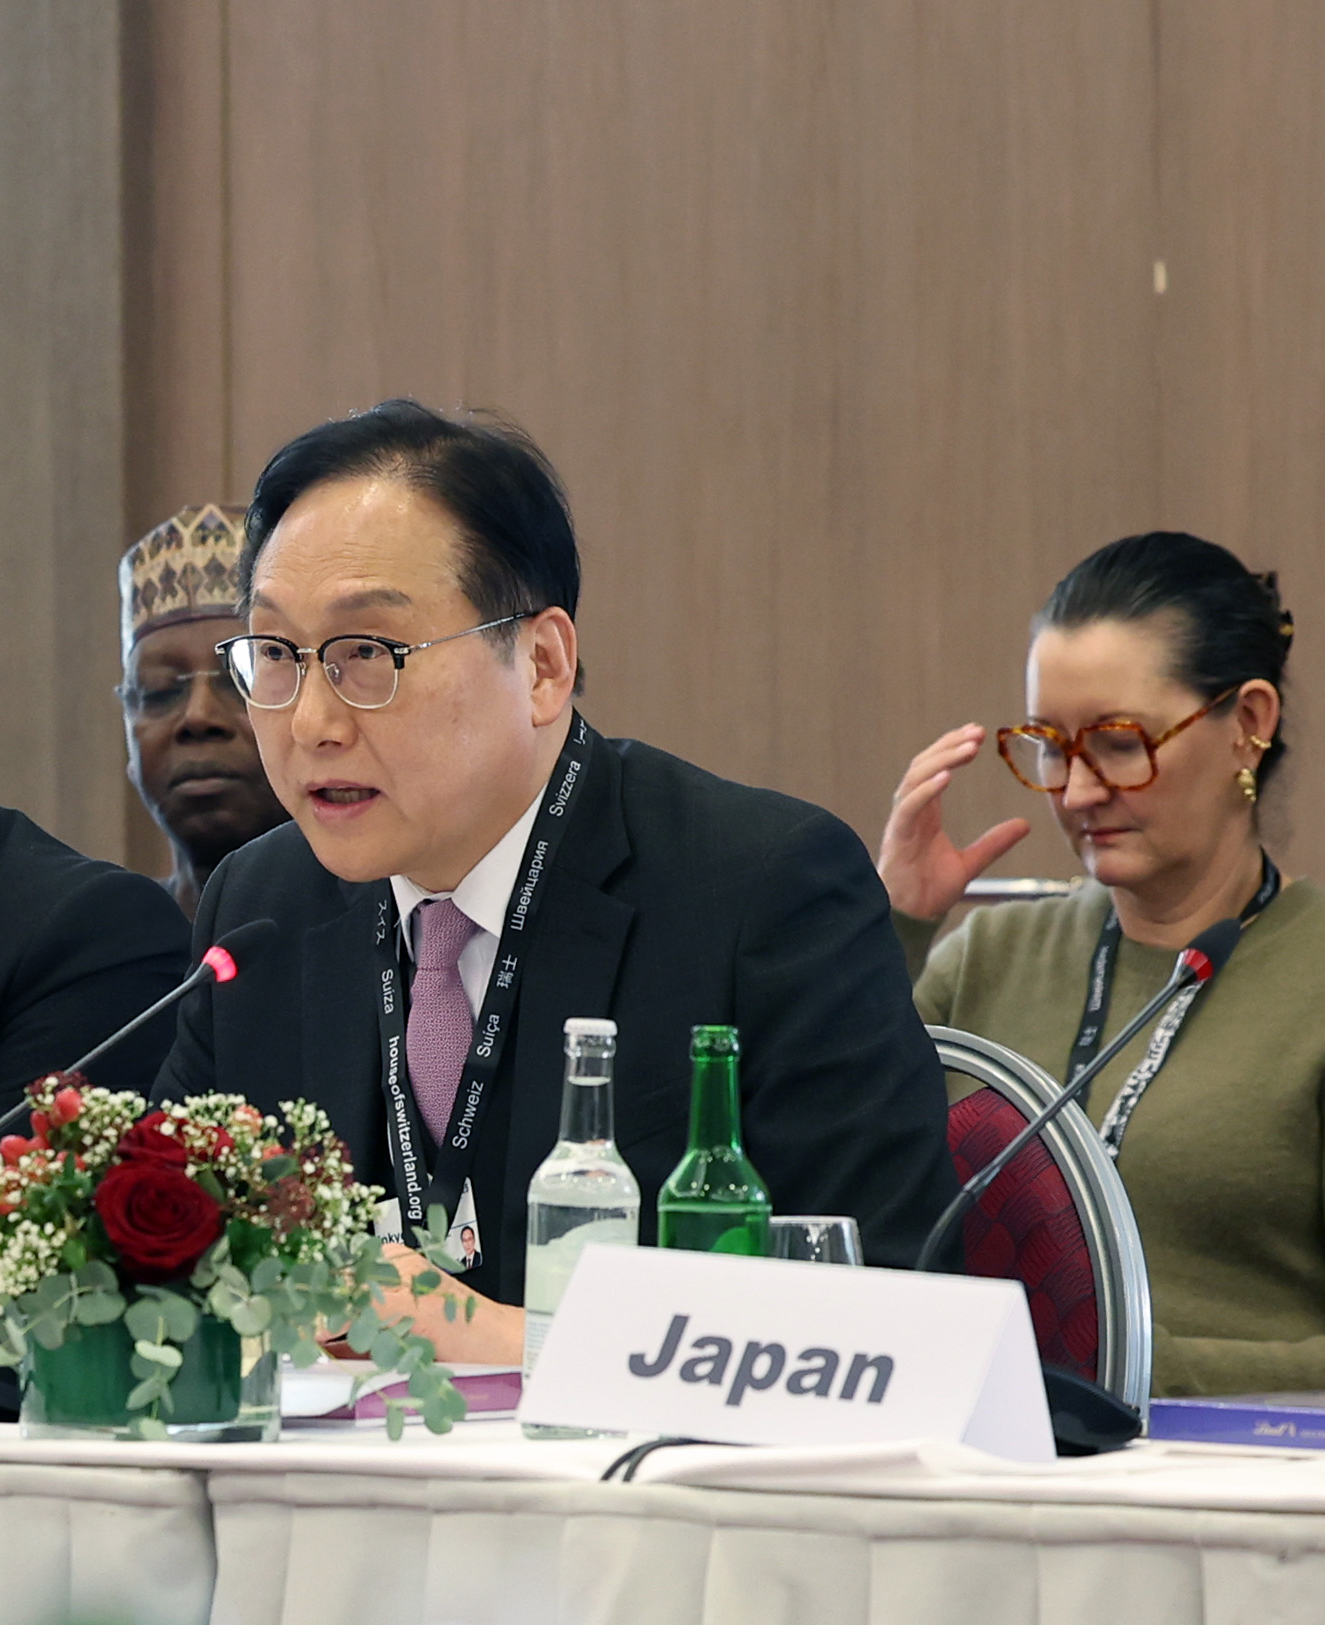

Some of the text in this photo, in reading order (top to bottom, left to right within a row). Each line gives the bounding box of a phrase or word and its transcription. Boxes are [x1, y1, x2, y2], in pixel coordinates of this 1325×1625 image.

[549, 760, 581, 817] Svizzera
[510, 840, 549, 931] Швейцария
[376, 900, 387, 946] スイス
[381, 968, 395, 1015] Suiza
[496, 954, 518, 989] 瑞士
[388, 1035, 424, 1220] houseofswitzerland.org
[452, 1080, 484, 1149] Schweiz
[627, 1313, 896, 1407] Japan
